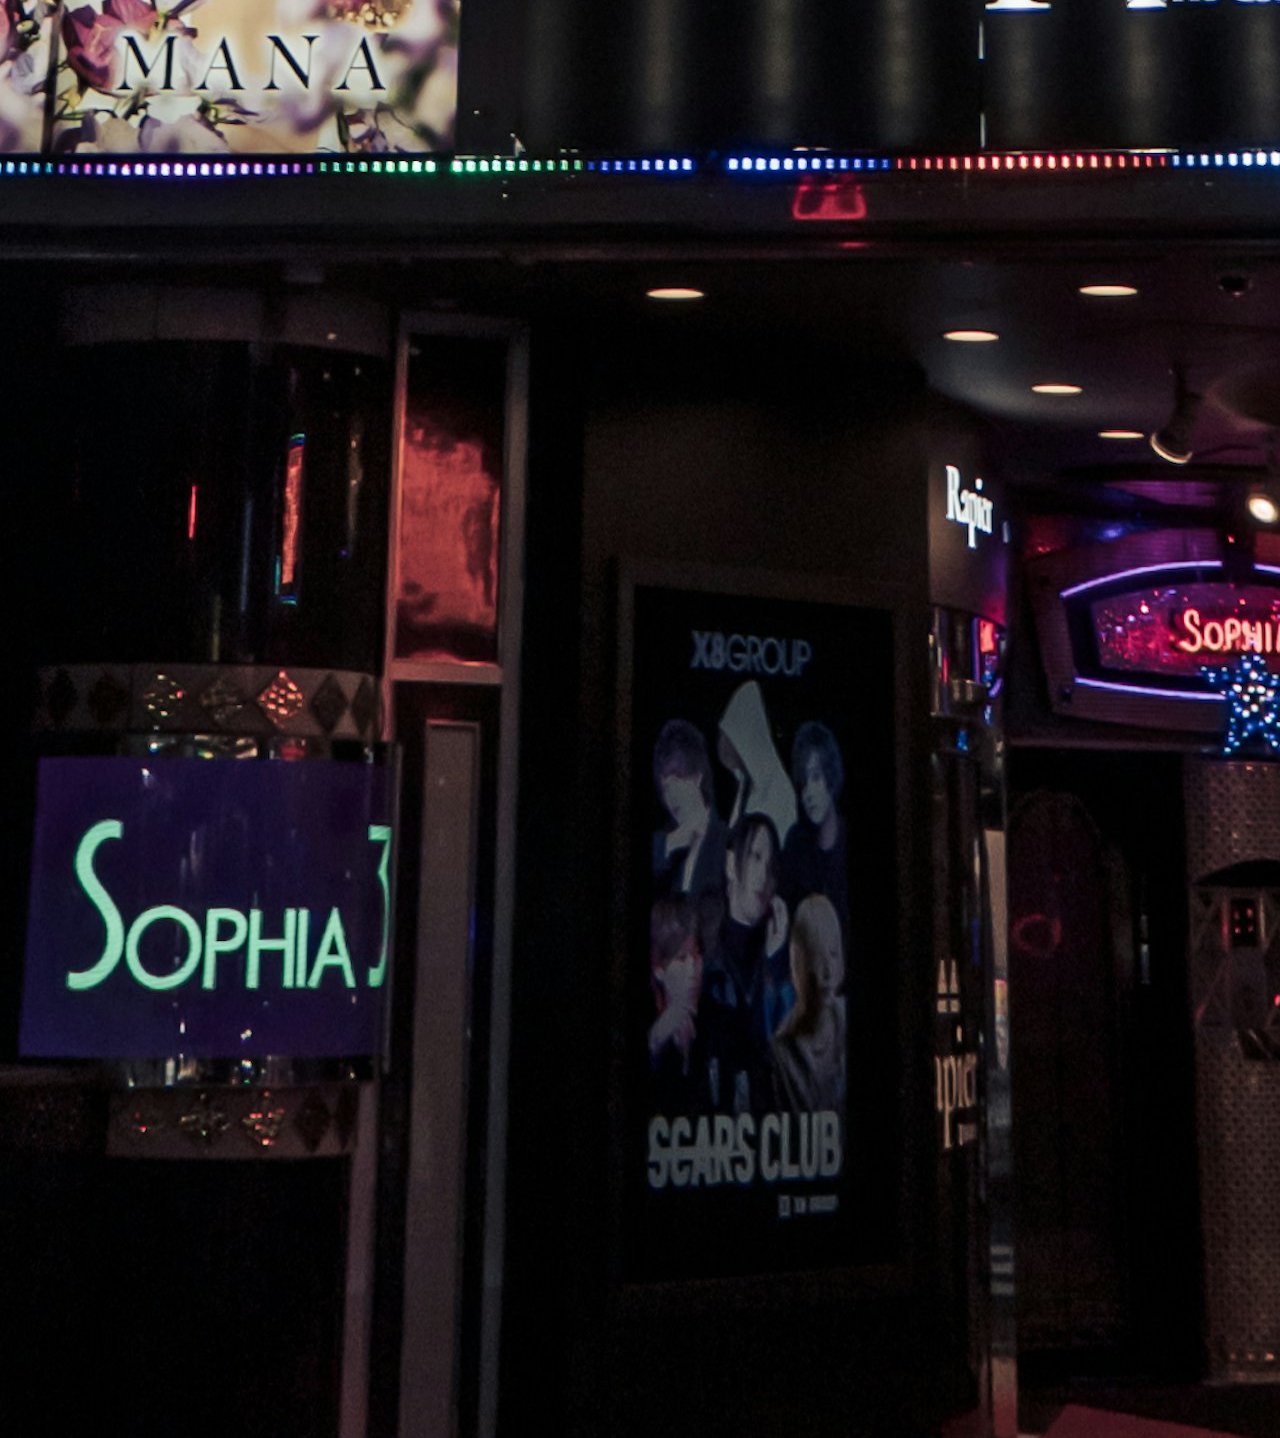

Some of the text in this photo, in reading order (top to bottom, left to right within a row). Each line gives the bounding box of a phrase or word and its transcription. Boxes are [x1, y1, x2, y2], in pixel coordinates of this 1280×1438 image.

[116, 32, 390, 92] MANA
[66, 818, 357, 991] SOPHIA
[760, 1108, 842, 1182] CLUB
